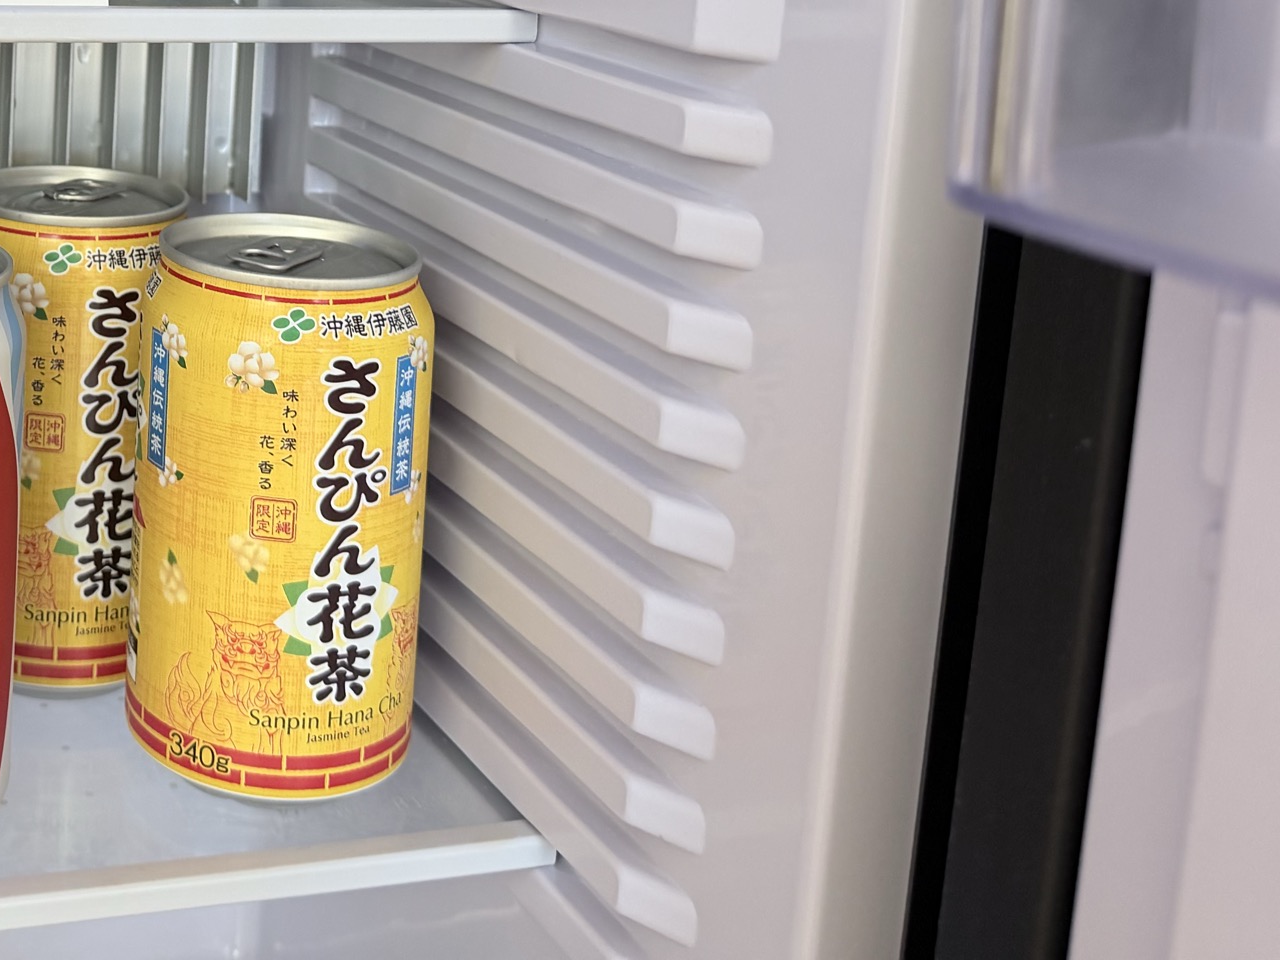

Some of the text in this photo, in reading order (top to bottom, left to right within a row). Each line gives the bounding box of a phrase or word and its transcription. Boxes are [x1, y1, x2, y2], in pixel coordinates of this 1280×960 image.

[320, 306, 418, 339] 沖縄伊藤園
[50, 315, 67, 386] 味わい深く
[31, 356, 47, 406] 花、香る
[151, 343, 167, 456] 沖縄伝統茶
[29, 417, 43, 446] 限定
[46, 420, 62, 448] 沖縄
[280, 390, 299, 468] 味わい深く
[395, 366, 414, 480] 沖縄伝統茶
[258, 435, 275, 491] 花、香る
[255, 504, 271, 534] 限定
[275, 506, 292, 535] 沖縄
[307, 359, 387, 702] さんぴん花茶
[24, 603, 87, 629] Sanpin
[75, 623, 116, 637] Jasmine
[248, 692, 402, 735] Sanpin Hana Cha
[306, 725, 370, 744] Jasmine Tea
[169, 732, 231, 774] 340g
